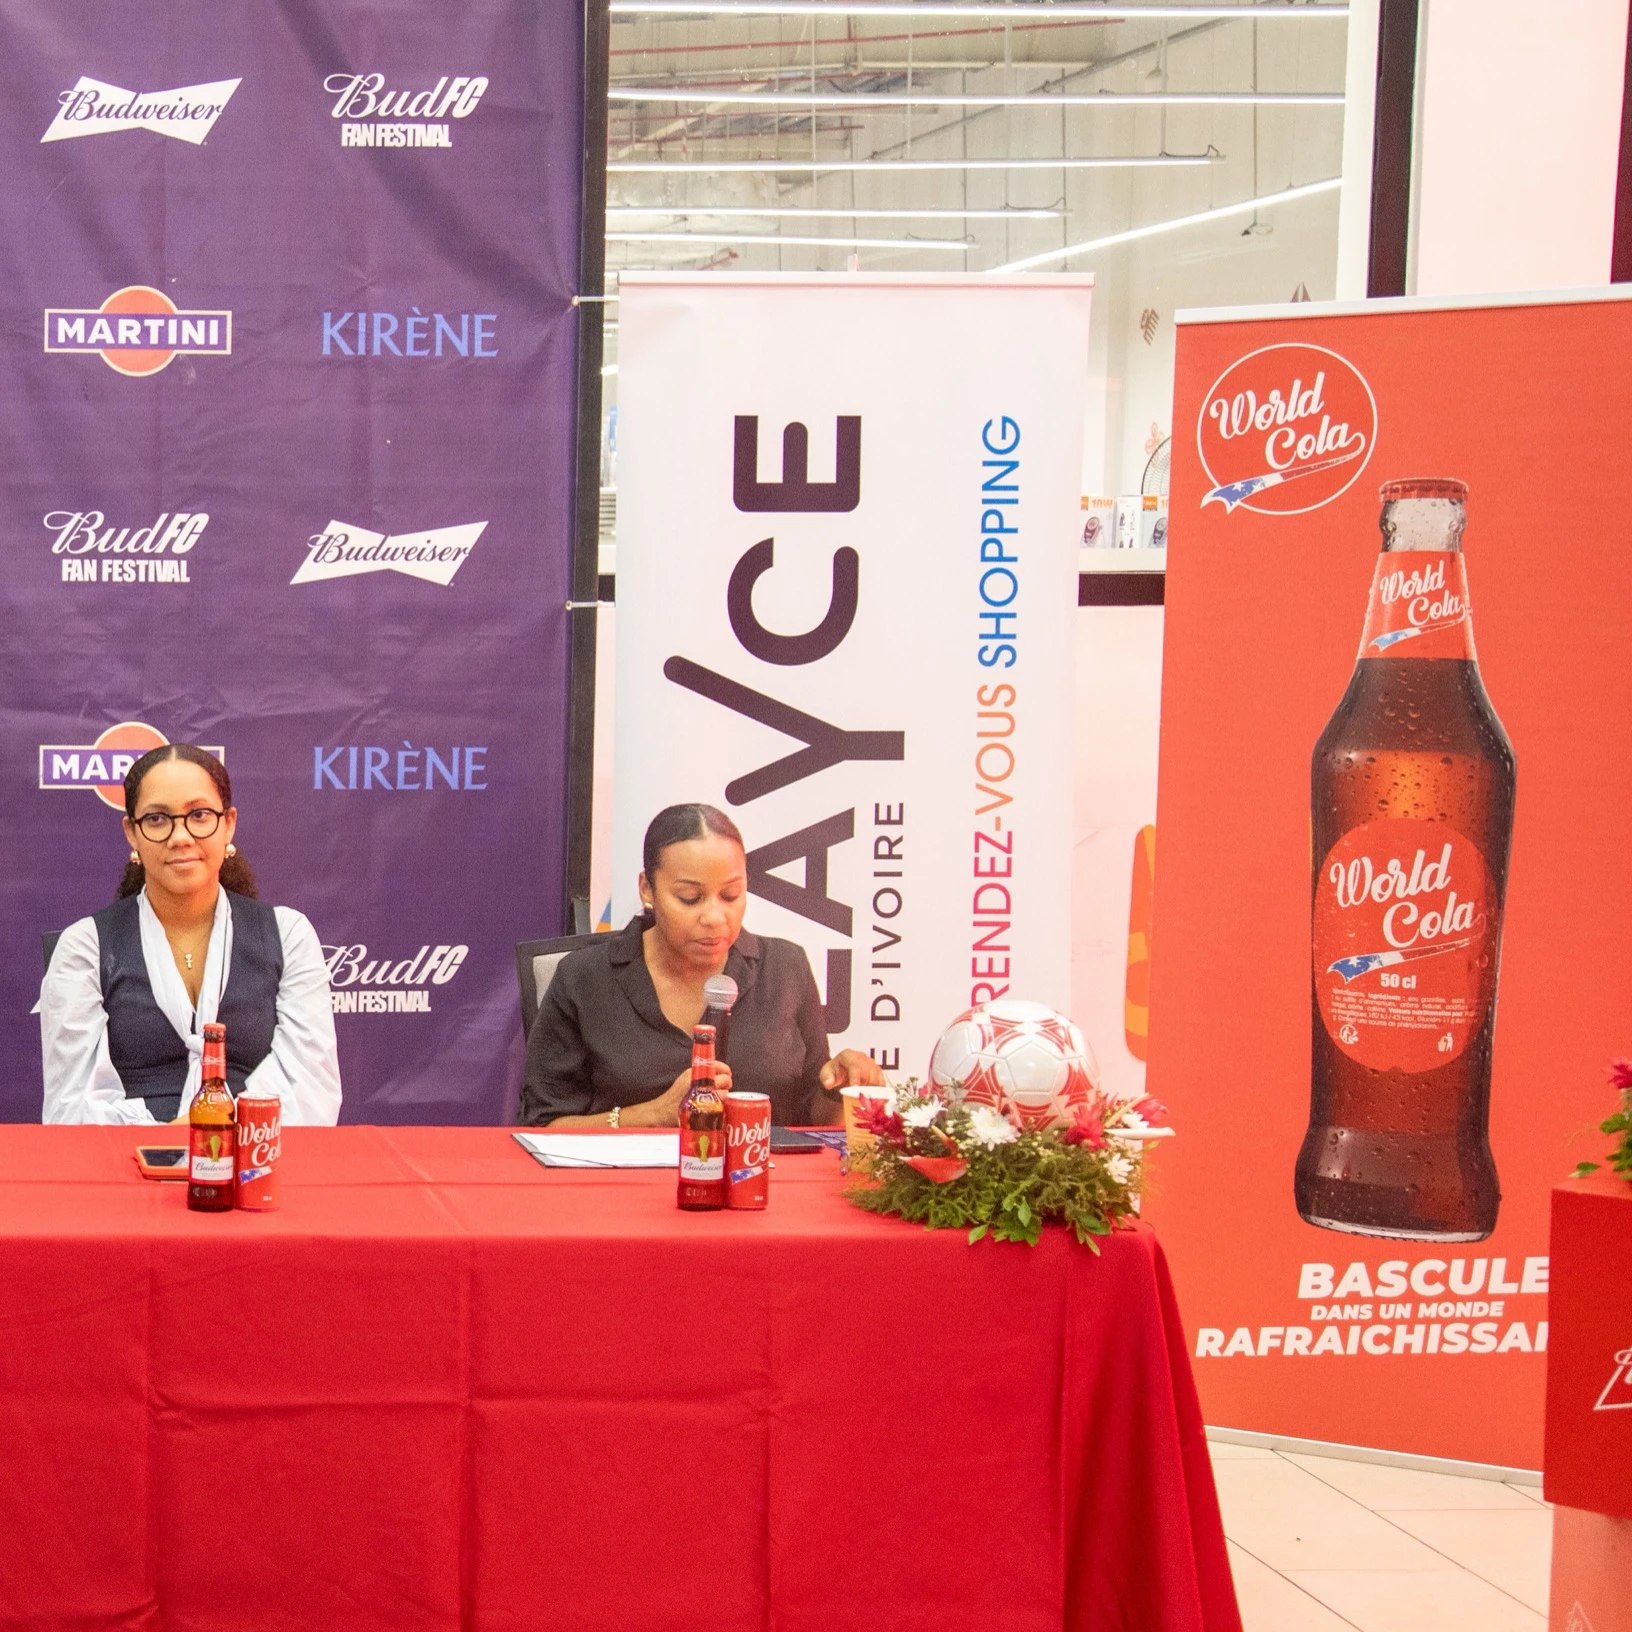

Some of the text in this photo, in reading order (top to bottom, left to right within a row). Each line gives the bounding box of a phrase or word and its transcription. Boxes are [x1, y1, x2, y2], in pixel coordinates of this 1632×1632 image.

[58, 90, 223, 121] Budweiser
[341, 123, 452, 148] FAN FESTIVAL
[57, 317, 219, 345] MARTINI
[322, 306, 498, 357] KIRÈNE
[1210, 371, 1325, 440] World
[1265, 415, 1351, 470] Cola
[61, 558, 191, 583] FAN FESTIVAL
[307, 533, 470, 564] Budweiser
[1379, 559, 1445, 604] World
[1407, 590, 1461, 627] Cola
[663, 415, 905, 1034] LAYCE
[971, 415, 1022, 1007] RENDEZ-VOUS SHOPPING
[313, 739, 488, 790] KIRÈNE
[1329, 843, 1452, 908] World
[870, 802, 904, 1021] D'IVOIRE
[1383, 891, 1475, 948] Cola
[330, 990, 432, 1013] FAN FESTIVAL
[1380, 972, 1416, 989] 50 cl
[1310, 1301, 1504, 1321] DANS UN MONDE
